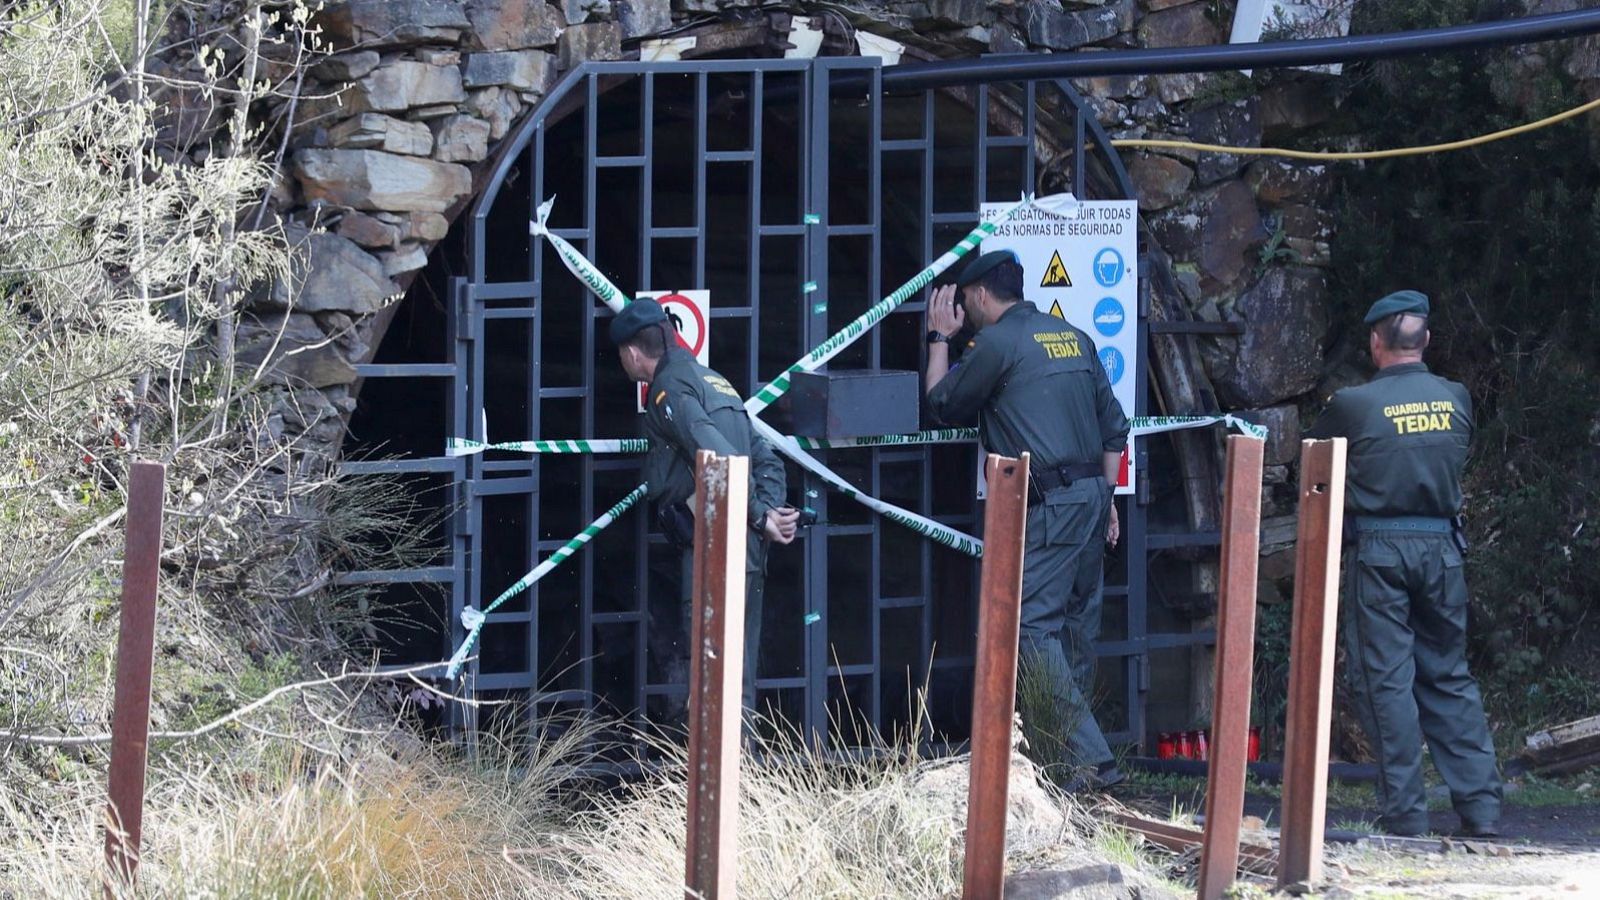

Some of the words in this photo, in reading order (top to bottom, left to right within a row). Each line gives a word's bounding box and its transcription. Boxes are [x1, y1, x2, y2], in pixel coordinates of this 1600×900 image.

[1000, 208, 1060, 221] BLIGATORIO
[1098, 208, 1131, 220] TODAS
[993, 224, 1011, 236] LAS
[1013, 224, 1051, 236] NORMAS
[1053, 224, 1066, 236] DE
[1068, 223, 1123, 235] SEGURIDAD
[811, 334, 846, 362] PASAR
[1043, 341, 1082, 359] TEDAX
[1384, 402, 1430, 417] GUARDIA
[1431, 400, 1455, 412] CIVIL
[1393, 413, 1452, 434] TEDAX
[620, 439, 649, 452] GUAR
